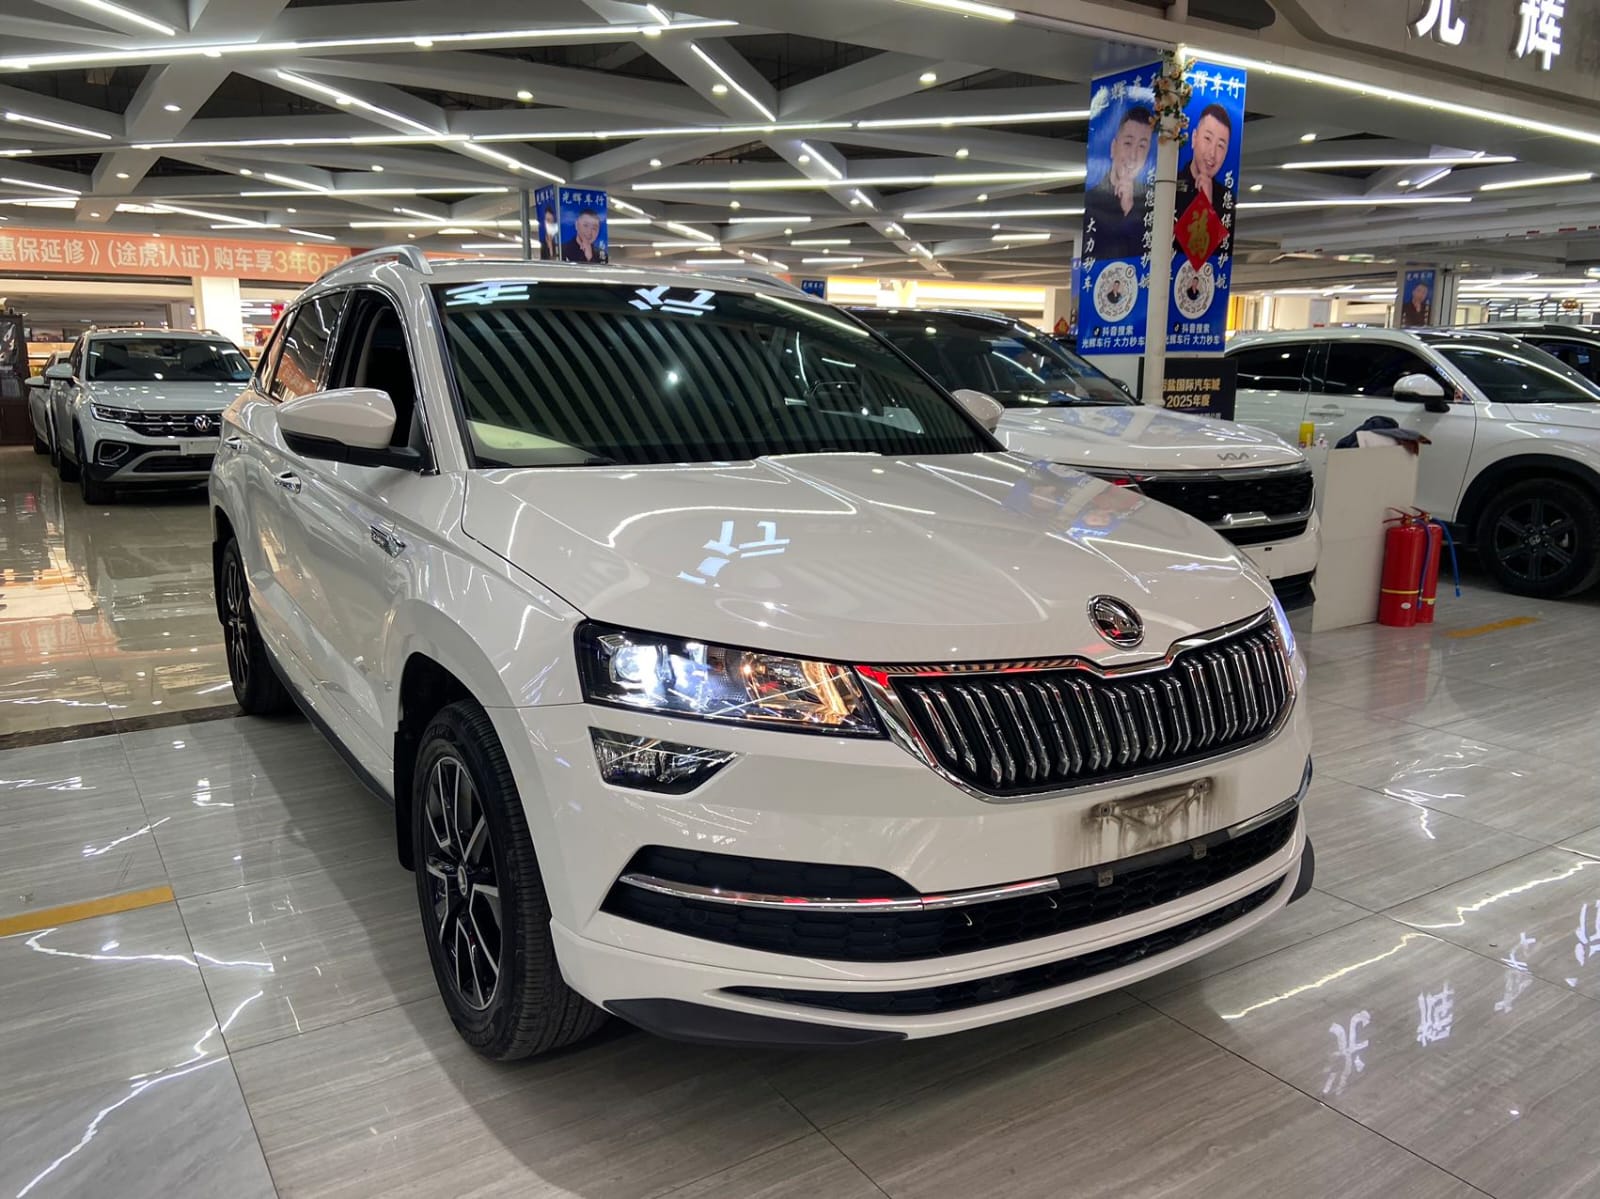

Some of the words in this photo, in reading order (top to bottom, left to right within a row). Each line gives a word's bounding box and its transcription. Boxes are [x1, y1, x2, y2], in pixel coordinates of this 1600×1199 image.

[1102, 325, 1134, 337] 抖音搜索
[1166, 394, 1211, 409] 2025年度
